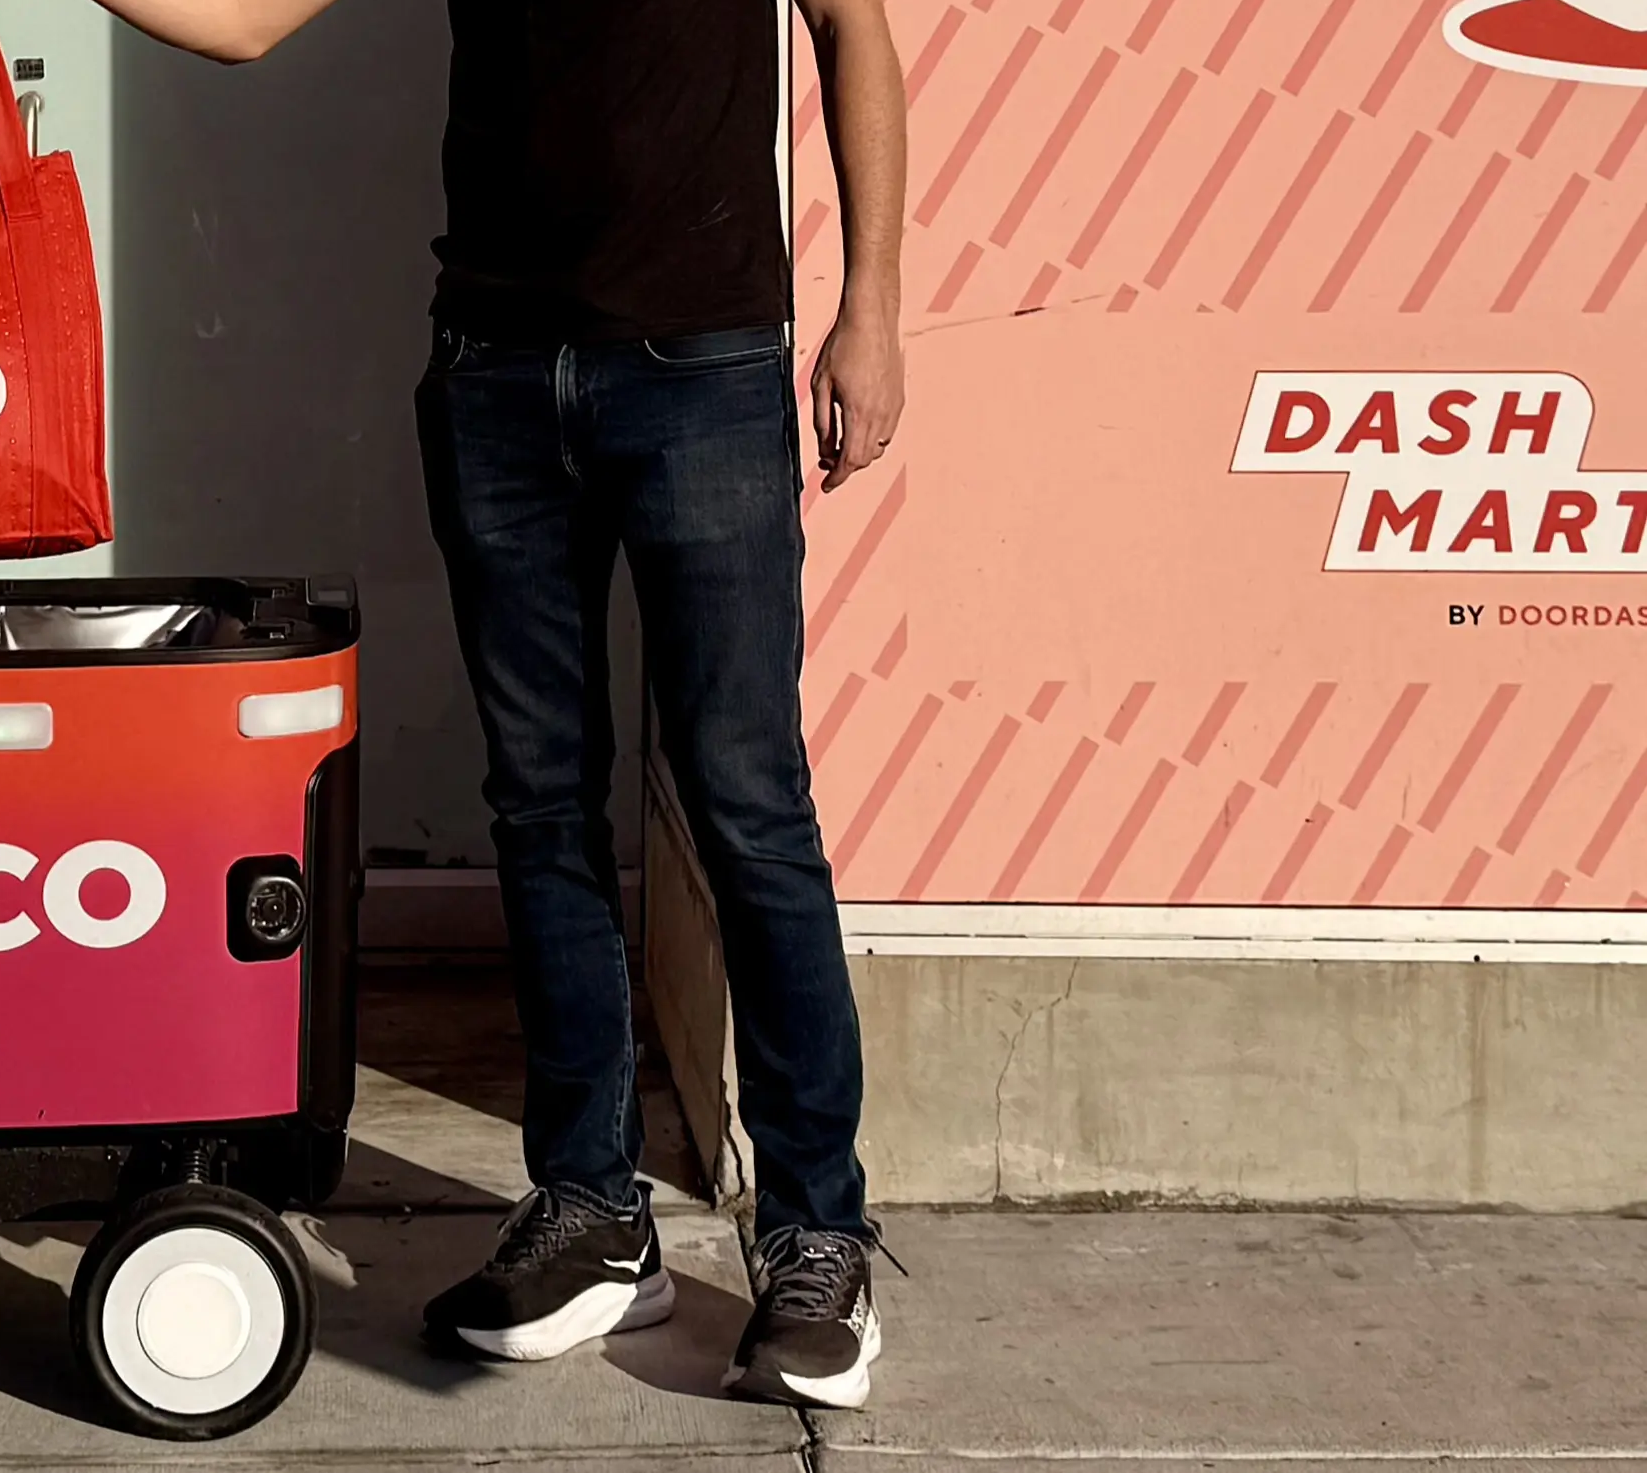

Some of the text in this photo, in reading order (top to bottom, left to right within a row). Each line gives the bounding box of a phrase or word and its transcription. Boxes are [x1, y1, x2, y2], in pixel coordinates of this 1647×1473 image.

[1264, 389, 1561, 455] DASH
[1357, 489, 1647, 554] MART
[1448, 604, 1485, 626] BY
